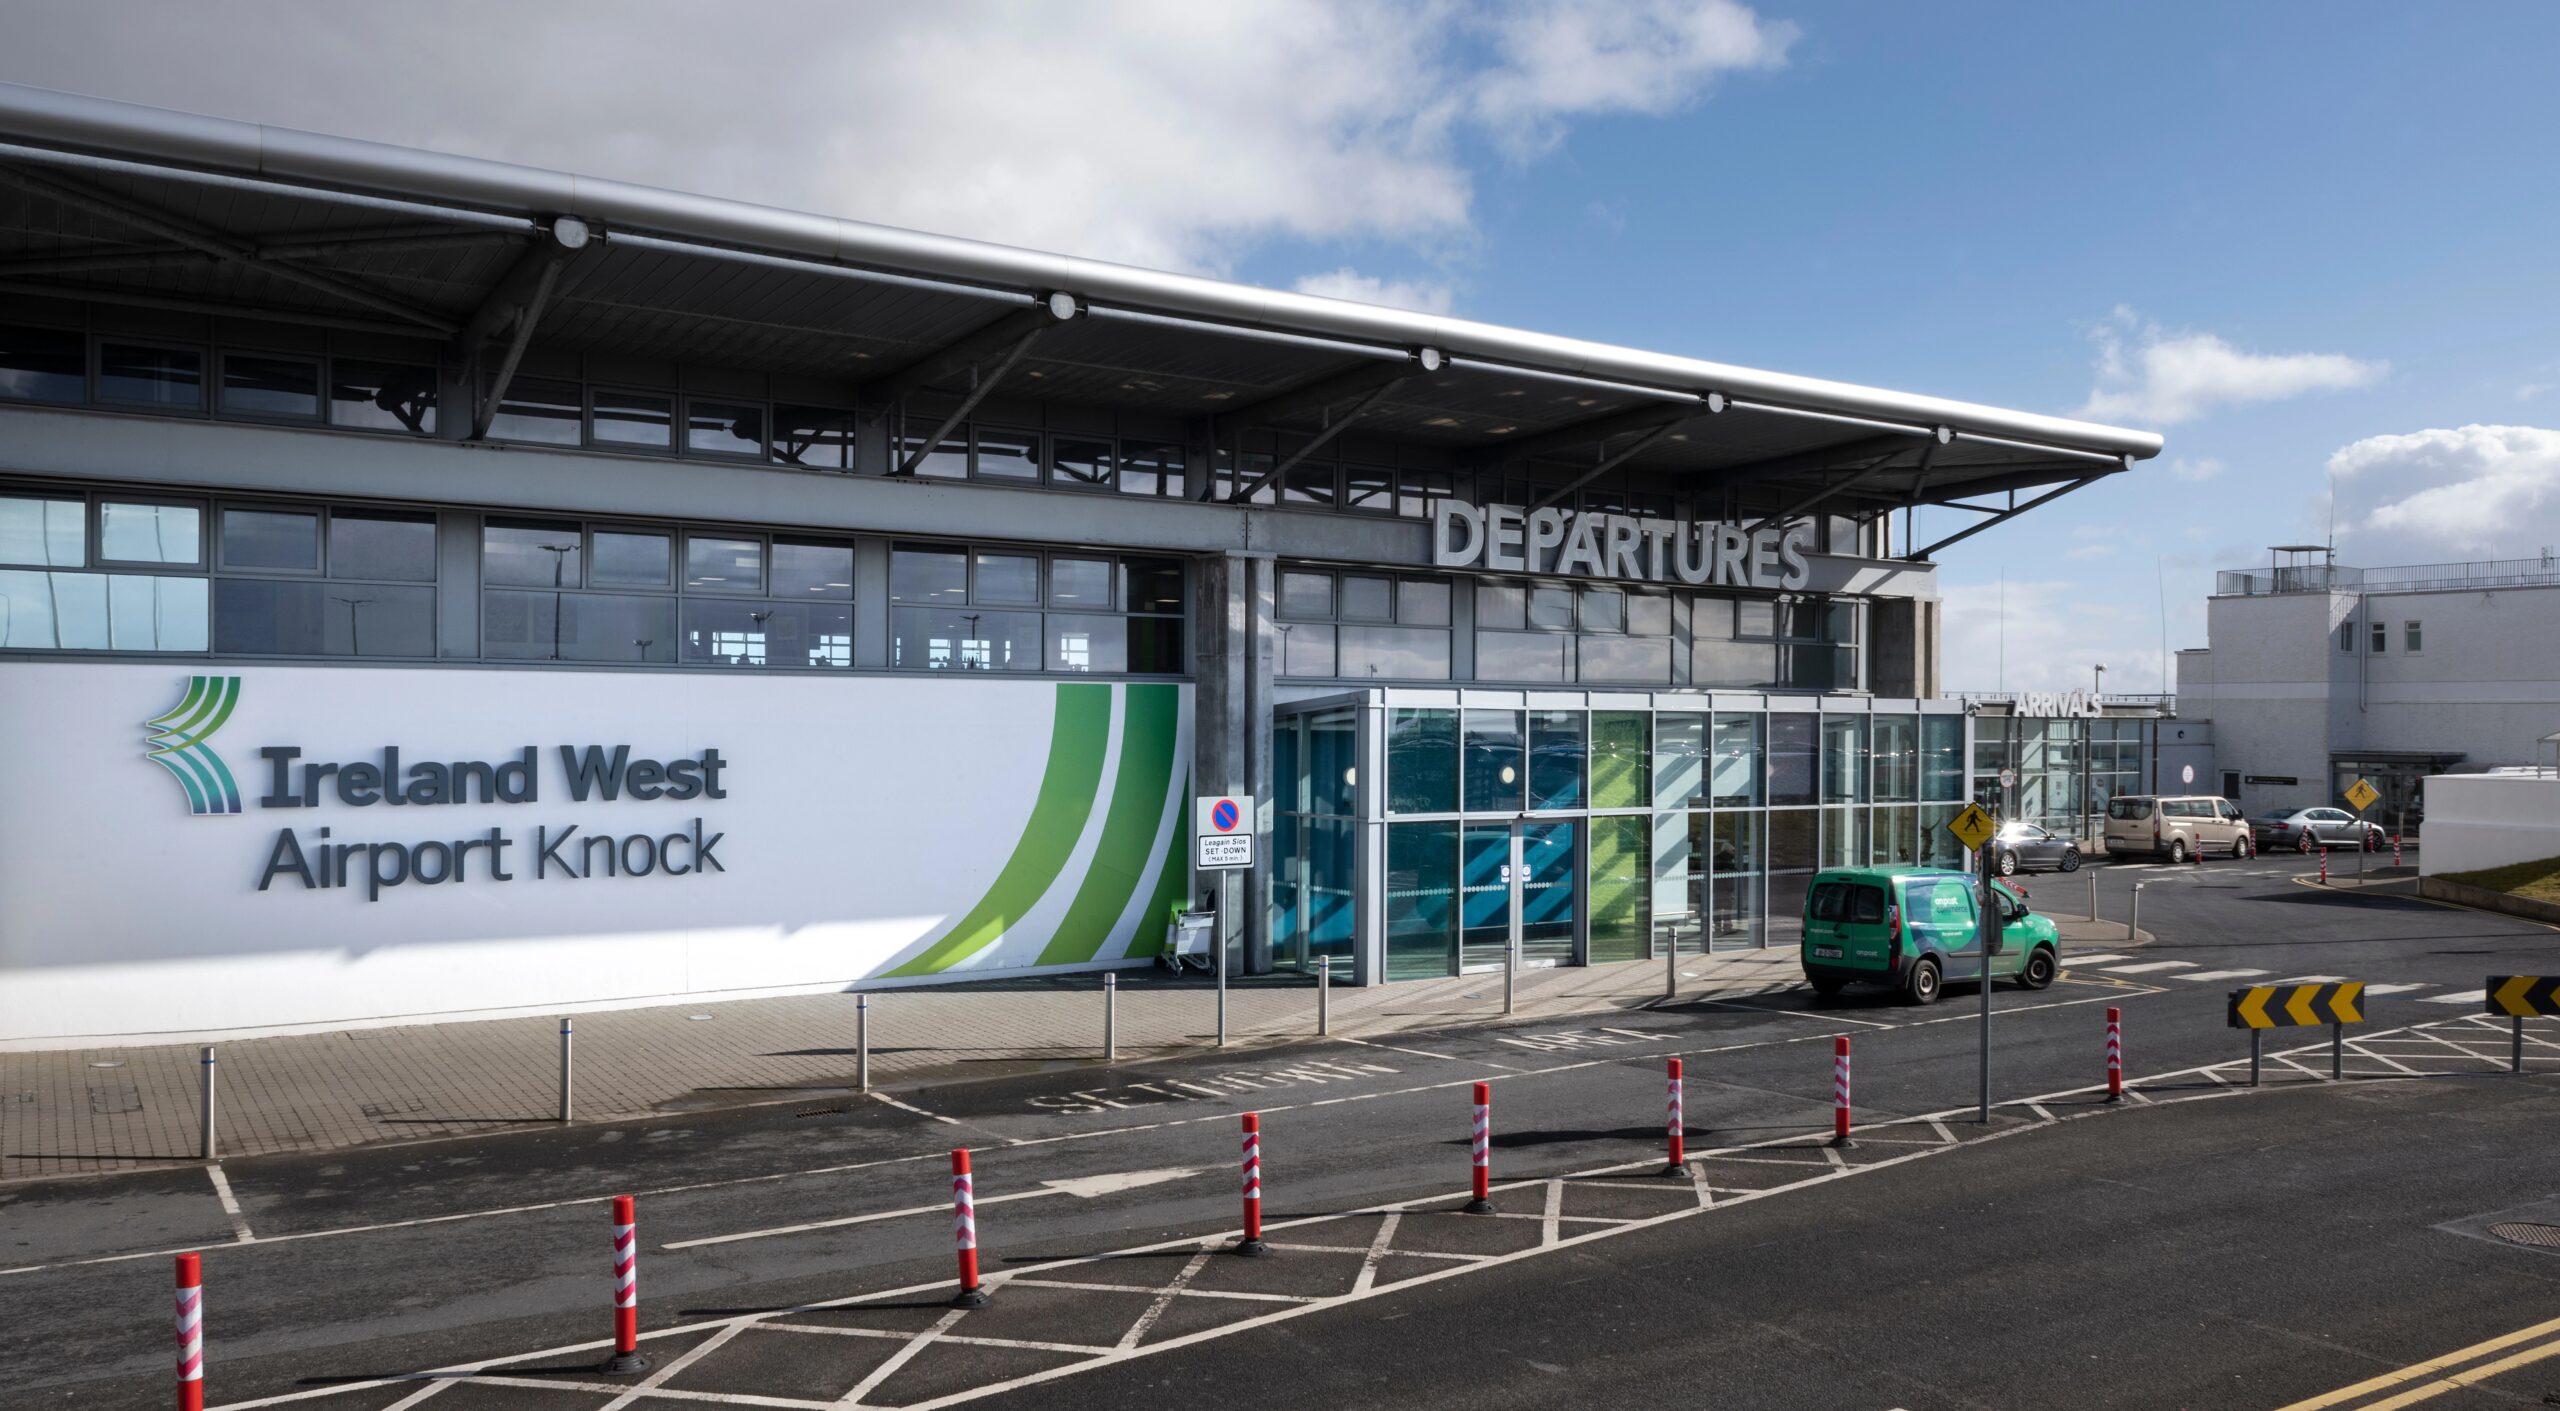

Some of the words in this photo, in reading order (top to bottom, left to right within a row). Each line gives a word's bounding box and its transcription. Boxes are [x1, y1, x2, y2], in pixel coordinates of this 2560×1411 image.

[1433, 499, 1810, 591] DEPARTURES
[2013, 691, 2103, 718] ARRIVALS
[260, 745, 538, 808] Ireland
[560, 744, 727, 802] West
[258, 826, 513, 902] Airport
[538, 817, 725, 879] Knock
